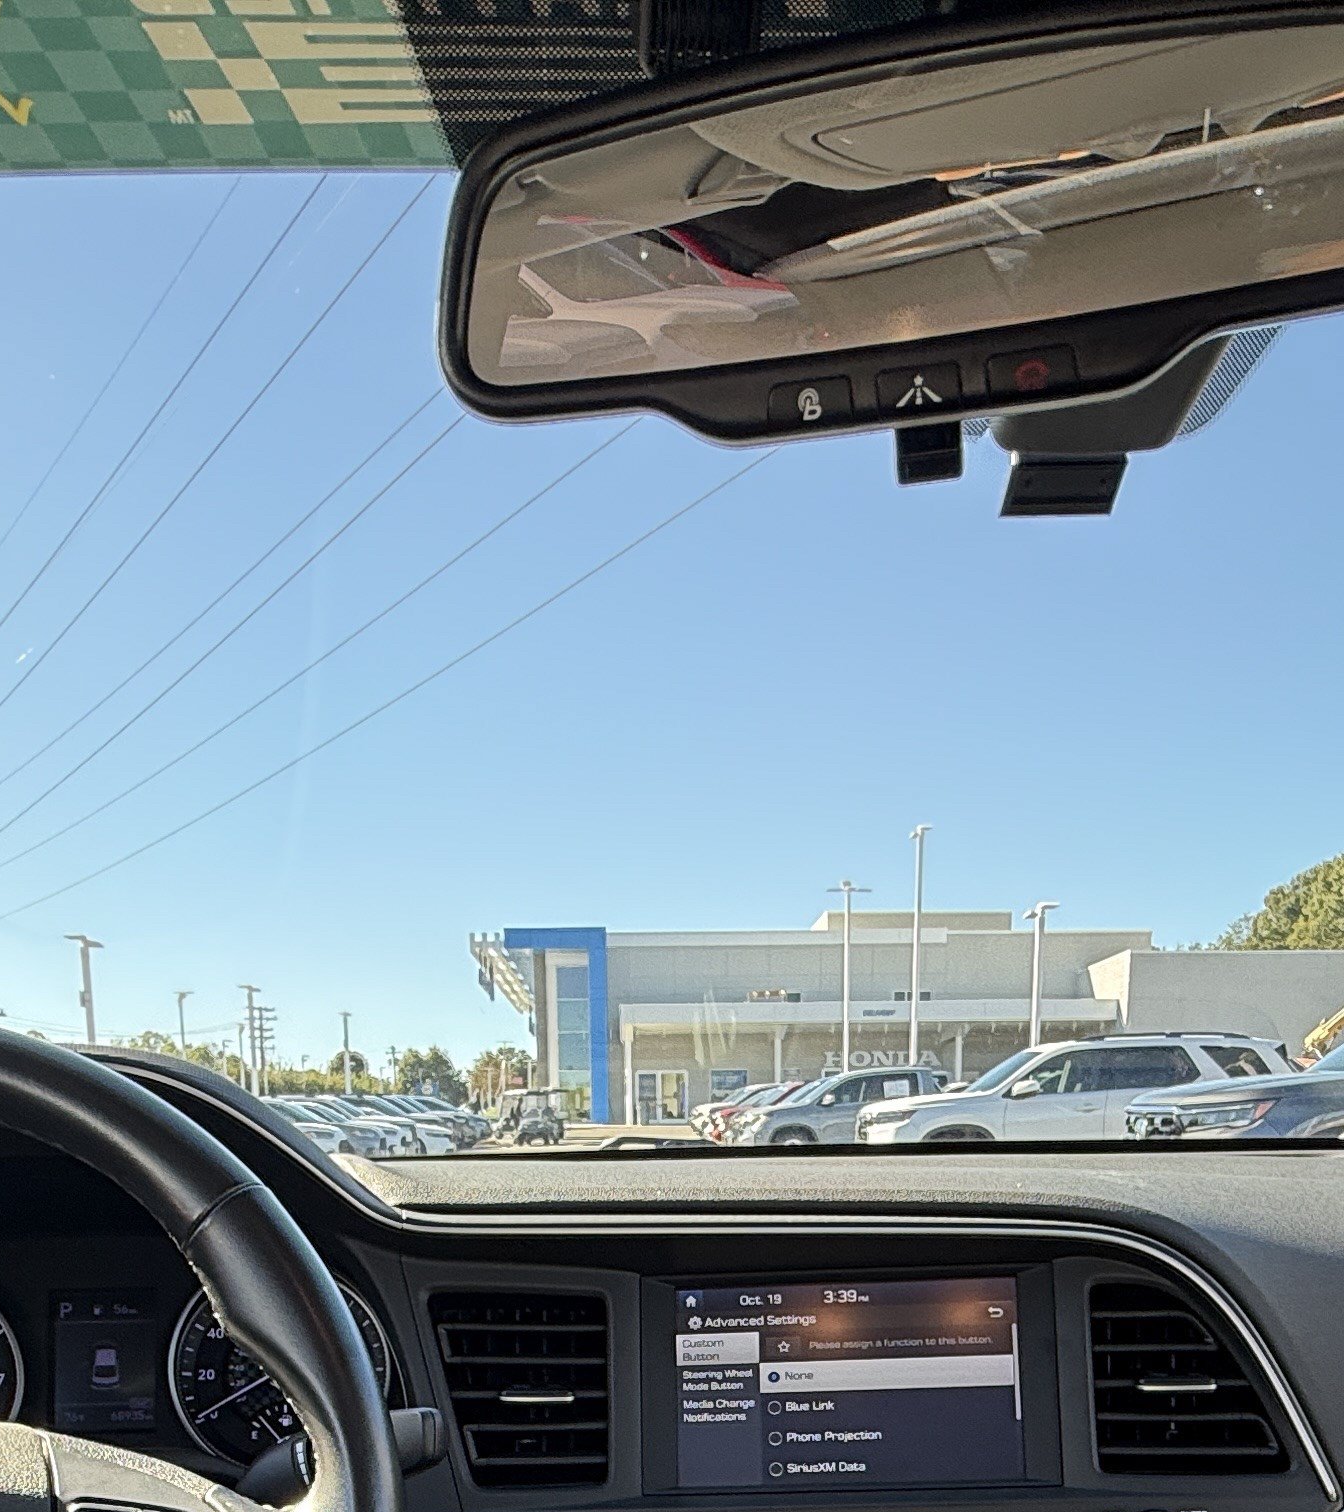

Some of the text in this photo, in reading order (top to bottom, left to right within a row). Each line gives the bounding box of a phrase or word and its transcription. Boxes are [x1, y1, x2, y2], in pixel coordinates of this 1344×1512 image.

[823, 1289, 857, 1304] 3:39
[59, 1302, 73, 1318] P
[704, 1314, 817, 1328] Advanced Settings
[206, 1327, 225, 1340] 40
[682, 1339, 724, 1349] Custom
[682, 1352, 720, 1362] Button
[197, 1368, 216, 1381] 20
[682, 1368, 753, 1381] Steering Wheel
[784, 1371, 814, 1381] None
[682, 1381, 744, 1391] Mode Button
[683, 1398, 756, 1410] Media Change
[785, 1400, 835, 1412] Blue Link
[683, 1412, 747, 1423] Notifications
[786, 1430, 883, 1443] Phone Projection
[786, 1461, 866, 1474] SiriusXM Data
